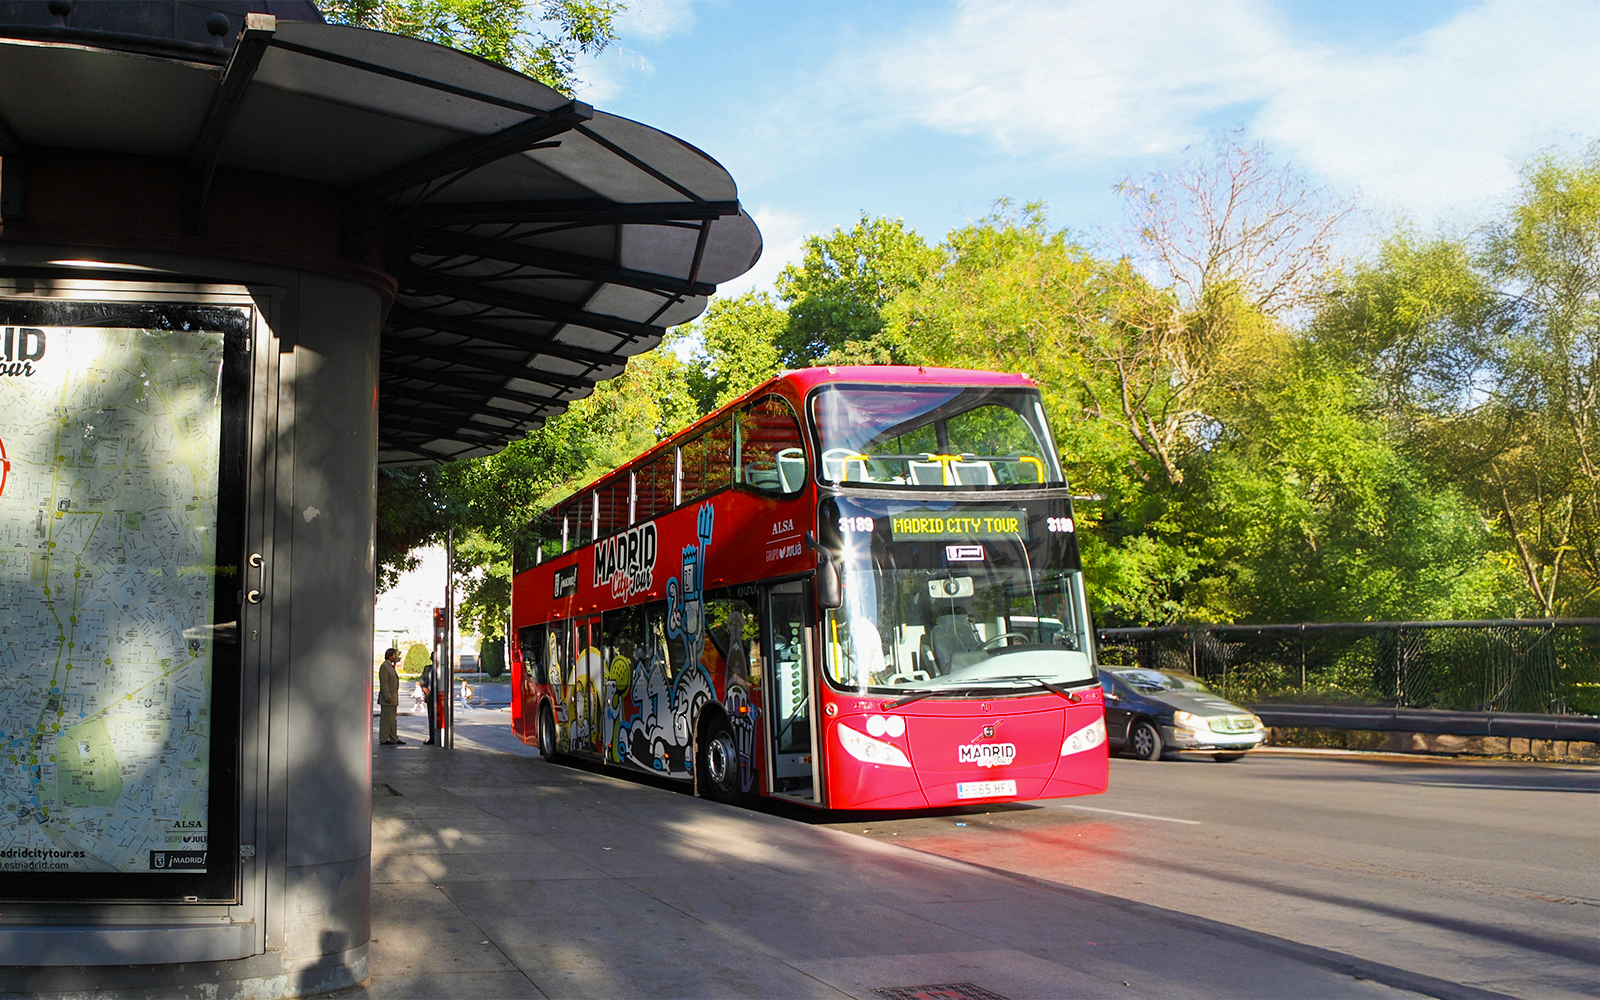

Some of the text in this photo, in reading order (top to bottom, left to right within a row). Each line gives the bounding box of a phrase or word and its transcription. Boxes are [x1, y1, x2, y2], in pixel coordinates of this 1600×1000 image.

[0, 327, 46, 362] ID
[0, 361, 36, 377] our
[772, 518, 795, 535] ALSA
[893, 517, 1020, 534] MADRID CITY TOUR
[594, 521, 657, 588] MADRID
[612, 569, 634, 603] City
[627, 563, 652, 597] Tour
[961, 745, 1015, 760] MADRID
[173, 820, 203, 829] ALSA
[0, 848, 86, 860] adridcitytour.es
[168, 852, 208, 868] ¡MADRID!
